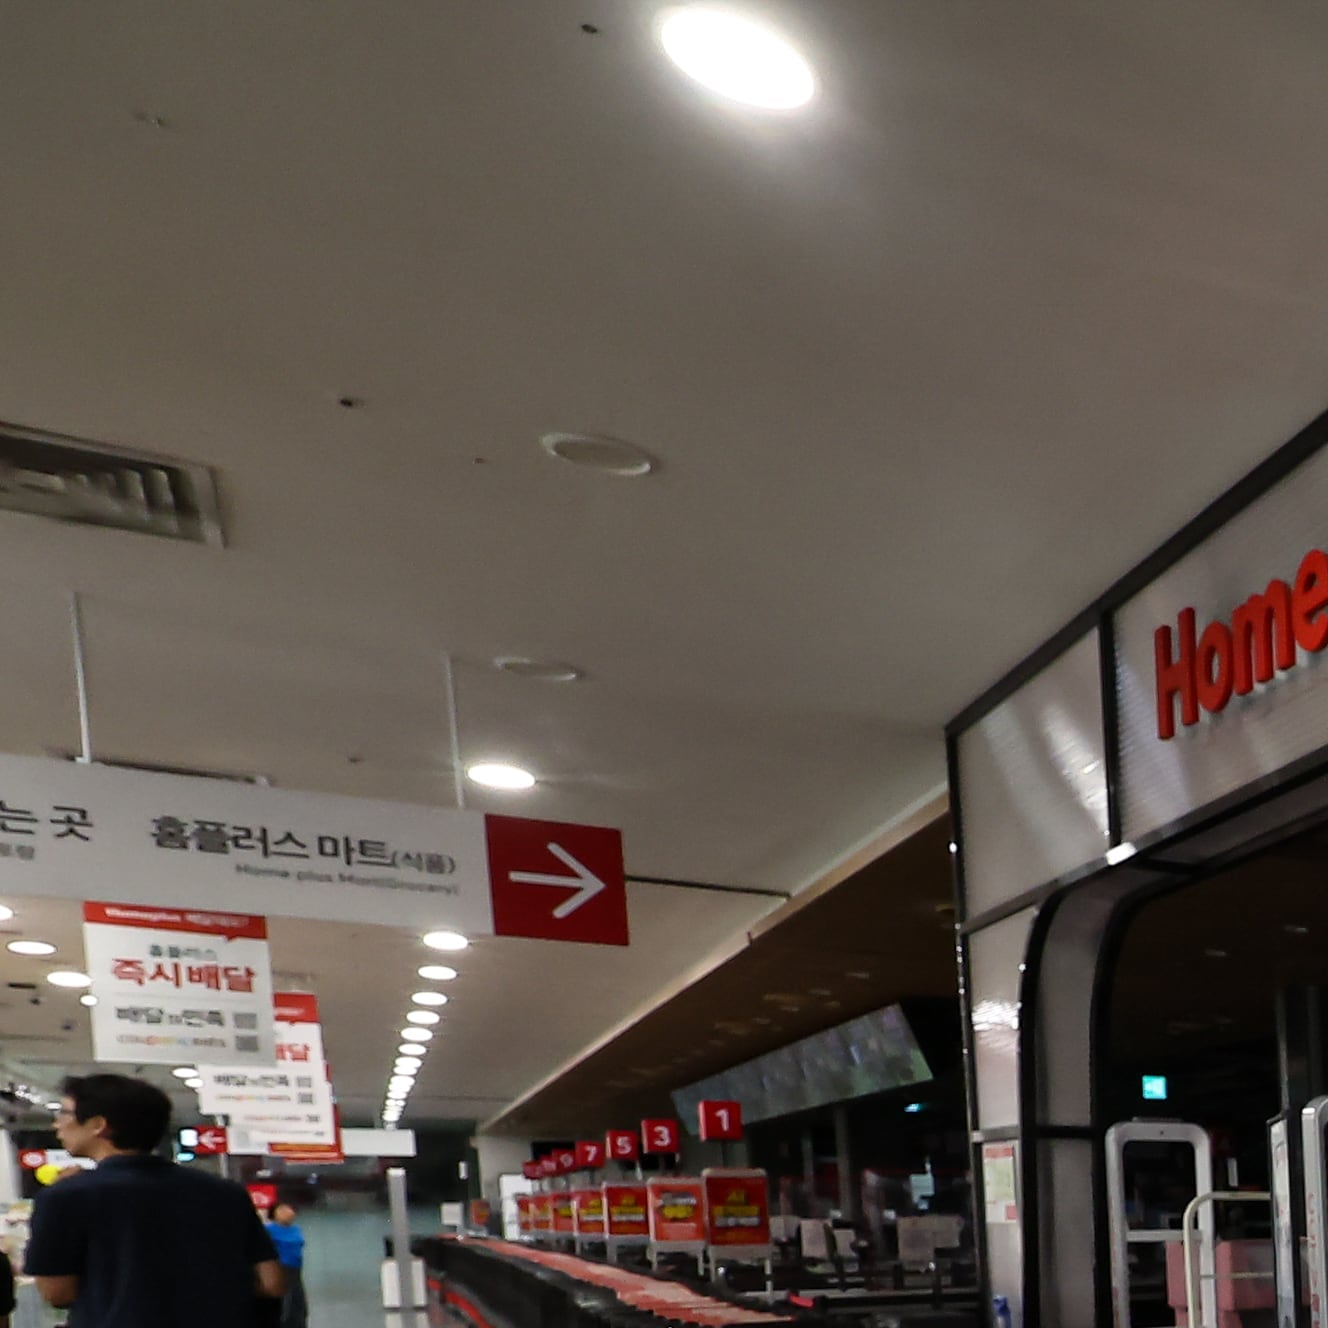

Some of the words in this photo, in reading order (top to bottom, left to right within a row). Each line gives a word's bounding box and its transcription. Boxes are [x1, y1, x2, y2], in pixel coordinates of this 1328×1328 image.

[49, 805, 94, 842] 곳
[151, 815, 310, 859] 홈플러스
[714, 1108, 730, 1133] 1
[615, 1135, 632, 1154] 5
[653, 1125, 672, 1147] 3
[585, 1145, 597, 1162] 7
